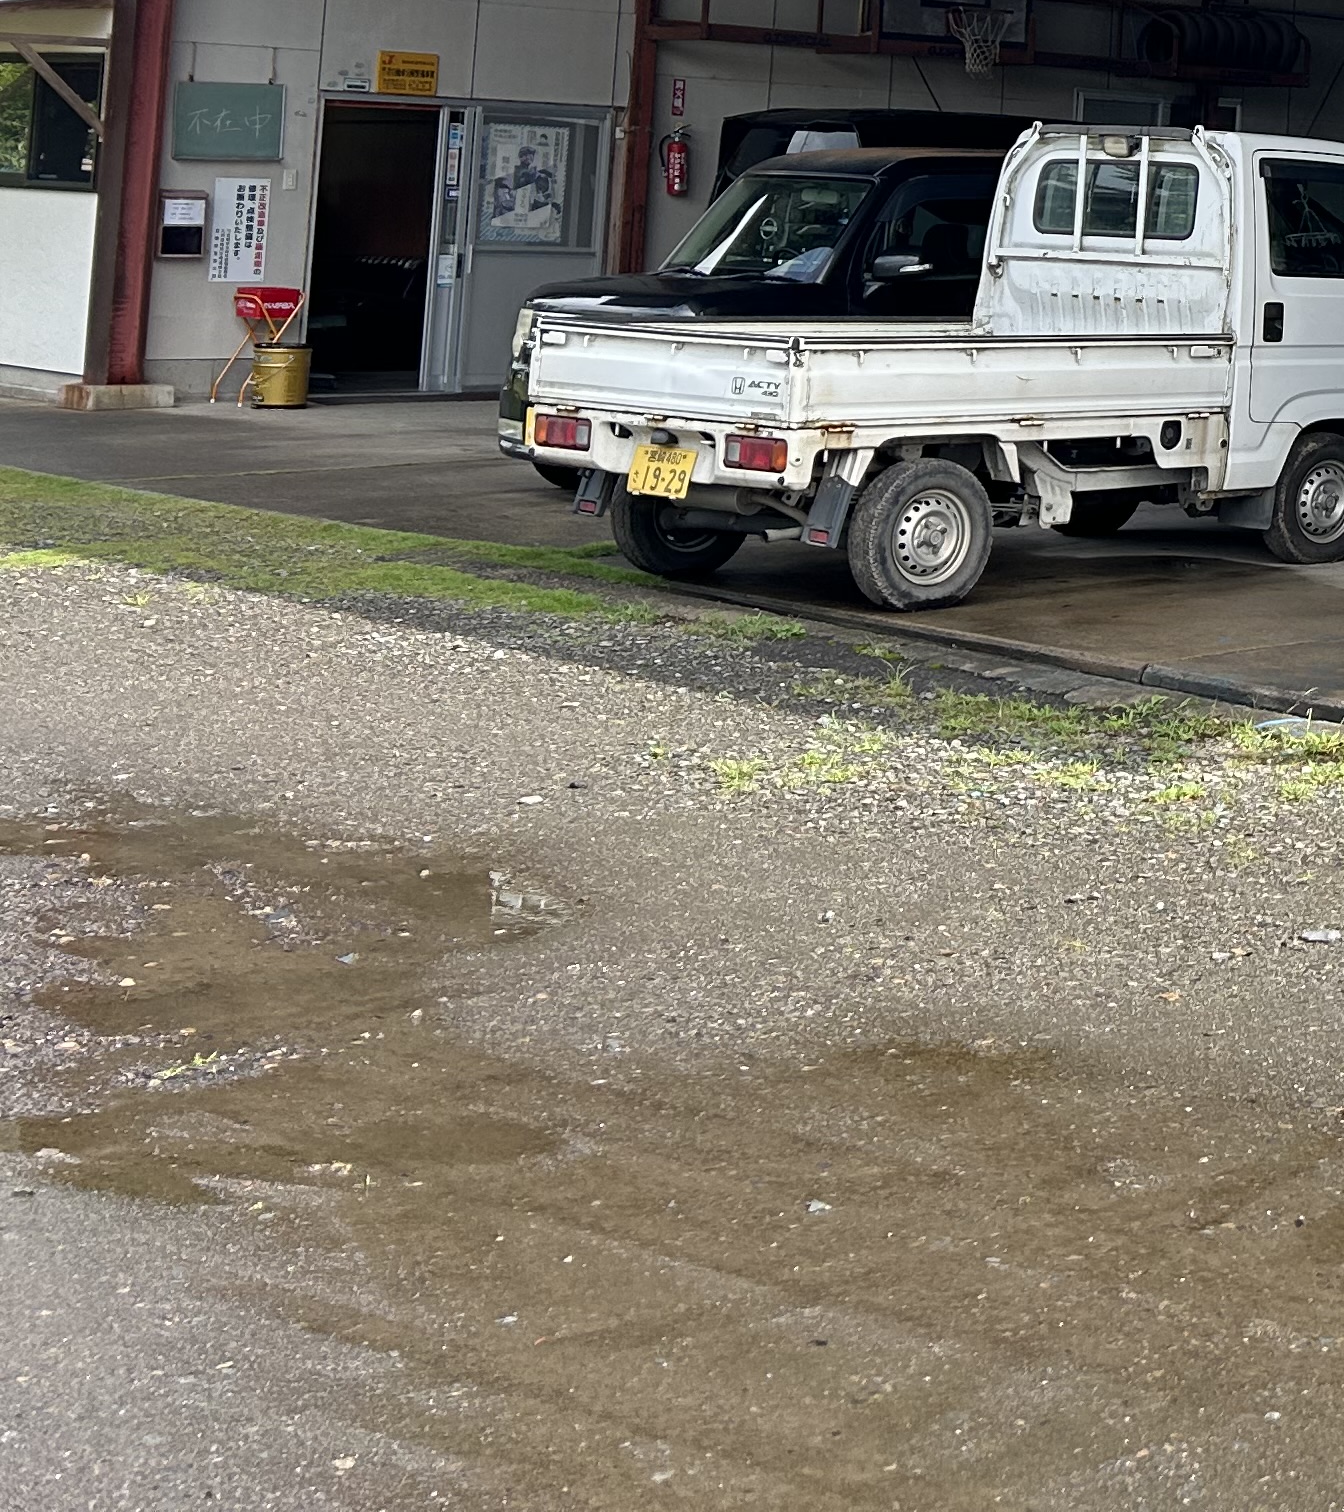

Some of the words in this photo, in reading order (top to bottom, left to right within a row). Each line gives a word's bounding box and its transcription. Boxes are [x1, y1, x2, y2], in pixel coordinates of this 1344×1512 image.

[187, 106, 272, 139] 不在中
[748, 380, 781, 390] ACTY
